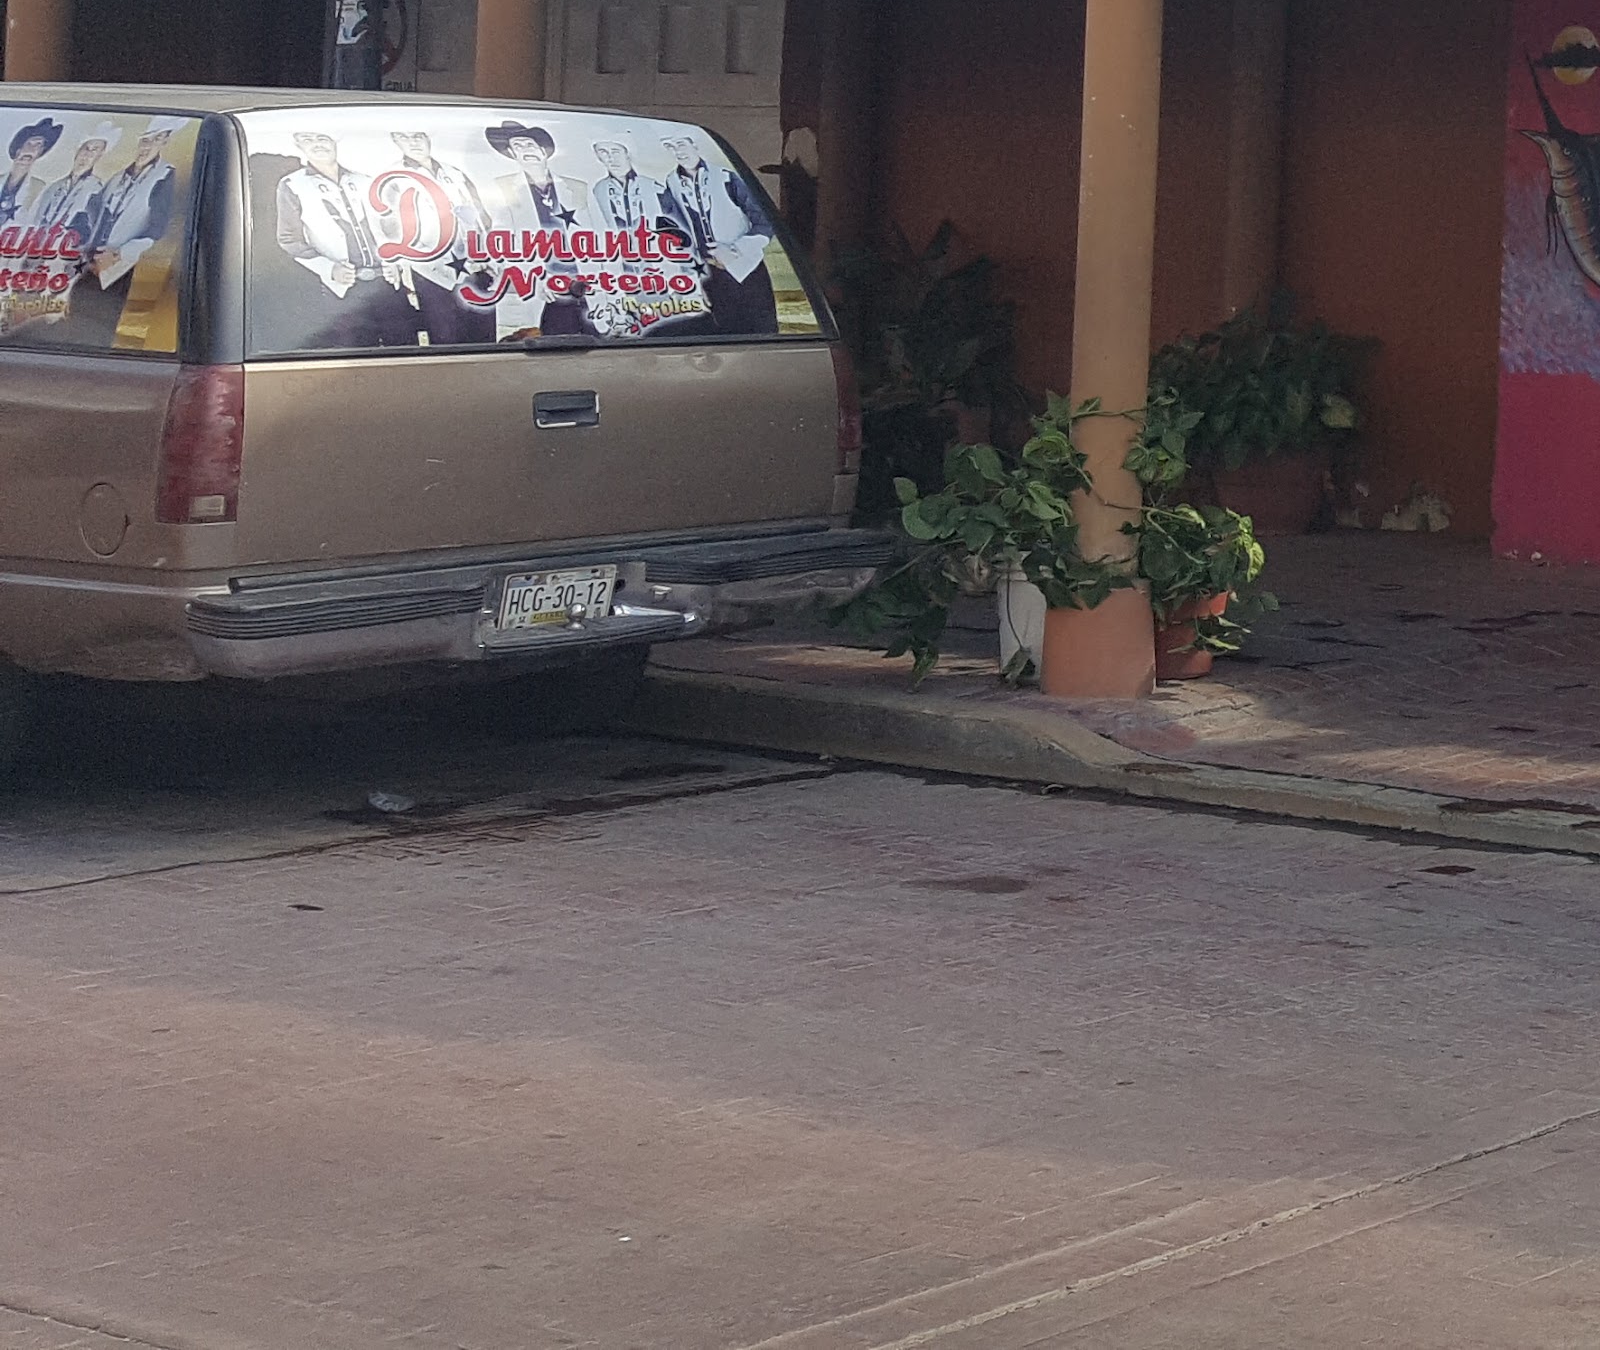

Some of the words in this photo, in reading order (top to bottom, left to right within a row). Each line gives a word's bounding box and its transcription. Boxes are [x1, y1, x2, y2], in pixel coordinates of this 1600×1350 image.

[369, 170, 692, 262] Diamante
[458, 264, 698, 306] Norteño
[508, 581, 608, 616] HCG-30-12
